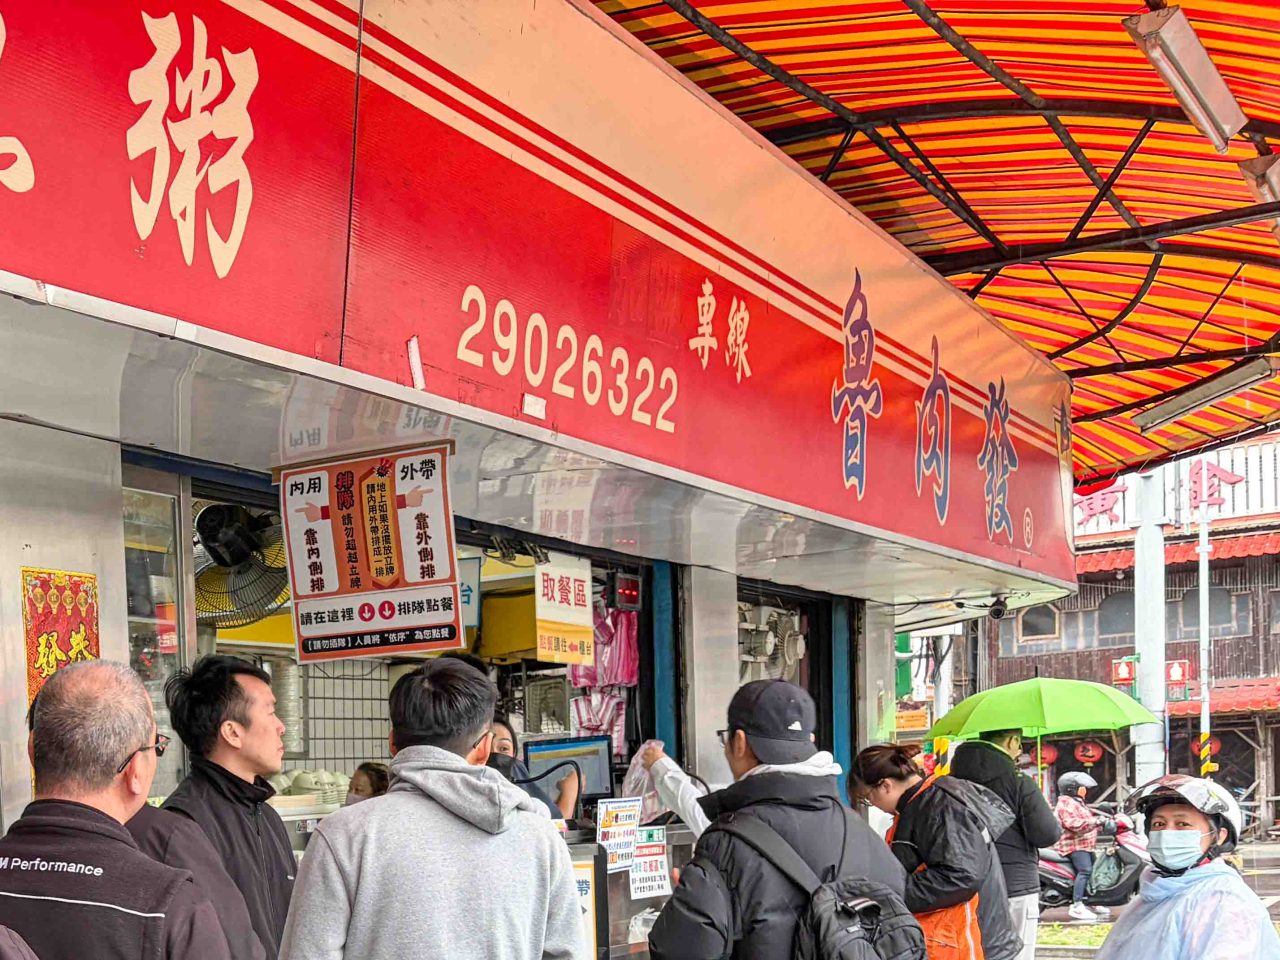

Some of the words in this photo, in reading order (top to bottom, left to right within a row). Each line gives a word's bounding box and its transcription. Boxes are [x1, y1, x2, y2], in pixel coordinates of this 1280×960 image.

[688, 277, 752, 384] 專線
[456, 284, 679, 434] 29026322
[289, 476, 322, 497] 內用
[400, 458, 436, 481] 外帶
[303, 528, 325, 592] 靠內側排
[414, 513, 436, 579] 靠外側排
[541, 572, 587, 608] 取餐區
[300, 607, 354, 626] 請在這裡
[397, 597, 454, 615] 排隊點餐
[11, 857, 104, 877] Performance
